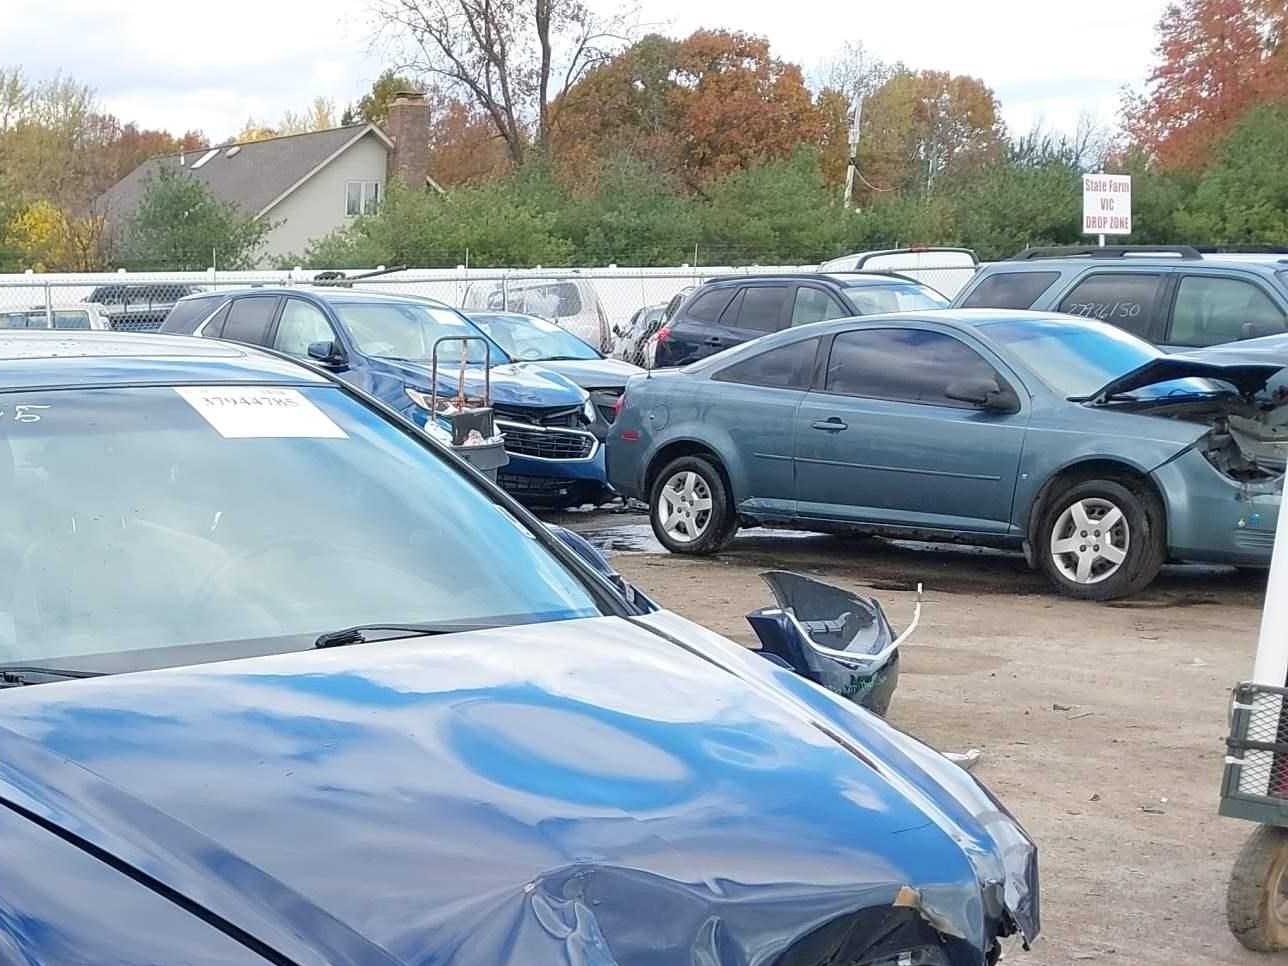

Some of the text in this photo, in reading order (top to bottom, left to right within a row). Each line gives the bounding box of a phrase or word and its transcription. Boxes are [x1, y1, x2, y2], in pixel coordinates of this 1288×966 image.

[1085, 178, 1130, 193] State Farm
[1100, 197, 1115, 211] VIC
[1085, 215, 1129, 230] DROP ZONE
